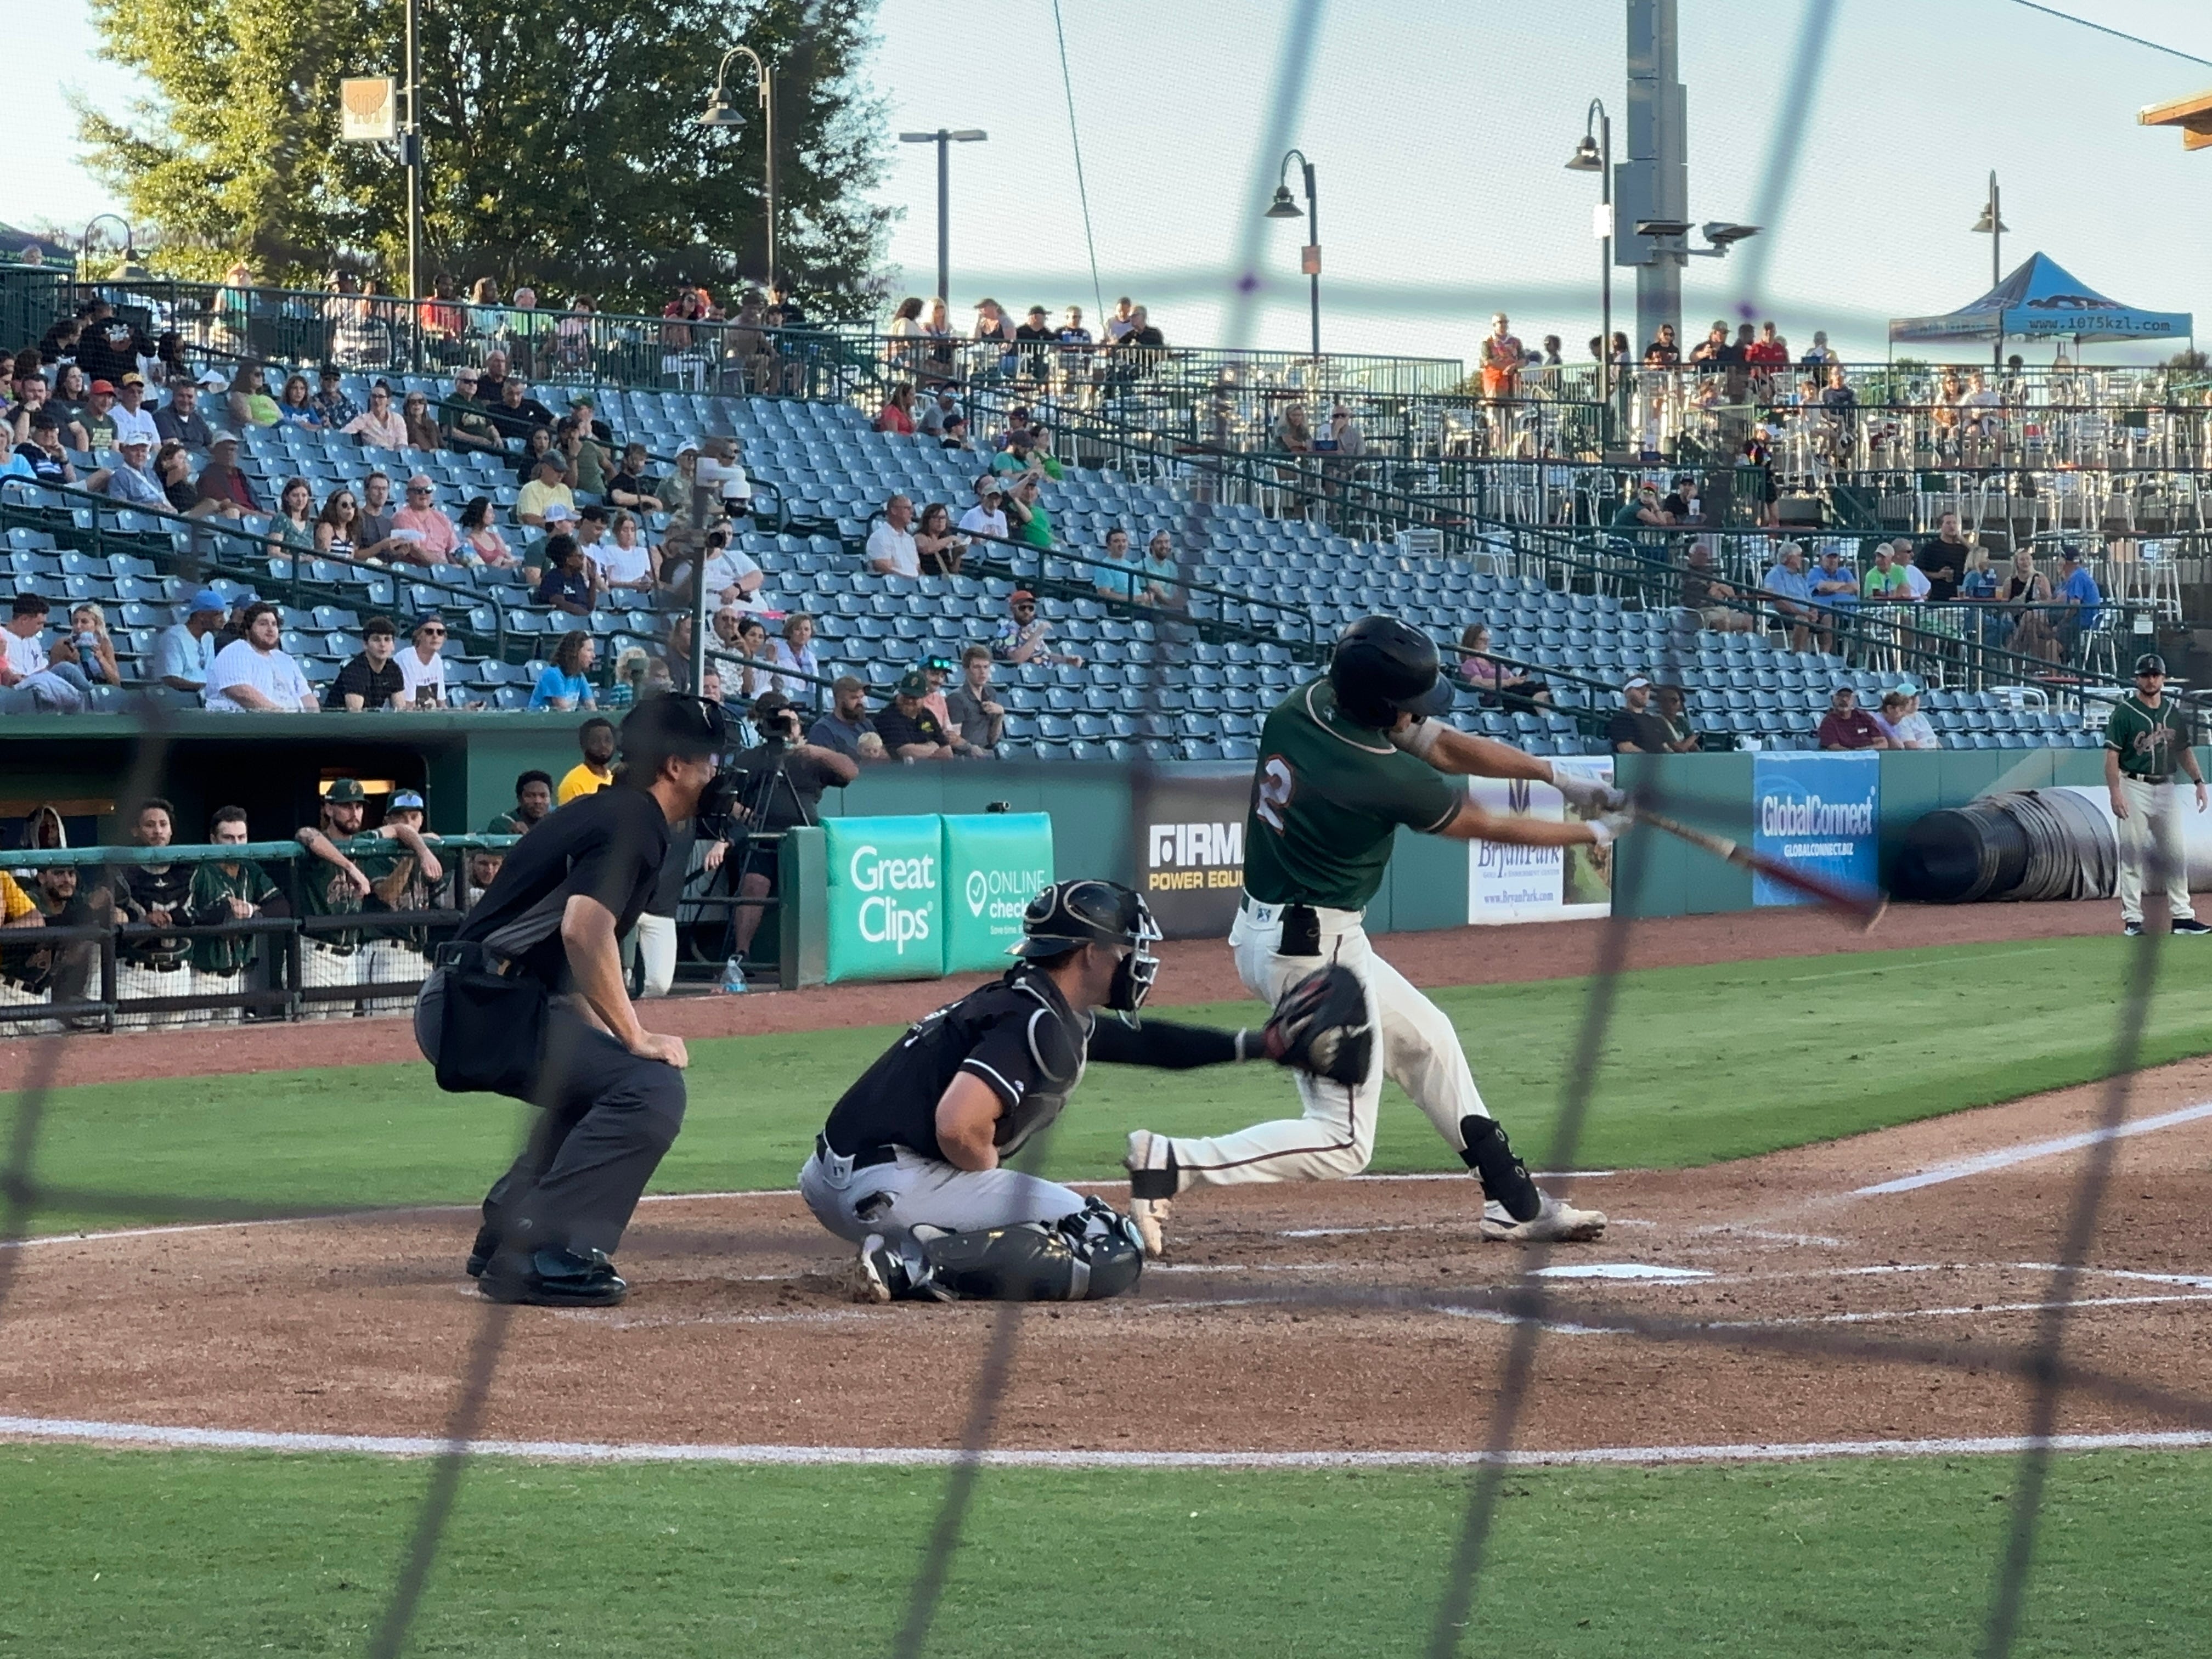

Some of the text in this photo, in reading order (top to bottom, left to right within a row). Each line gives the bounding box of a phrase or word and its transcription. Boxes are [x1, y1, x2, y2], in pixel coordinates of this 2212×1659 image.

[352, 94, 381, 124] 101
[2029, 317, 2171, 331] www.1075kzl.com
[1762, 795, 1873, 837] GlobalConnect
[1784, 843, 1854, 857] GLOBALCONNECT.BIZ
[851, 845, 935, 891] Great
[989, 870, 1045, 894] ONLINE
[1149, 871, 1203, 890] POWER
[1484, 888, 1554, 904] www.BryanPark.com
[859, 896, 930, 955] Clips
